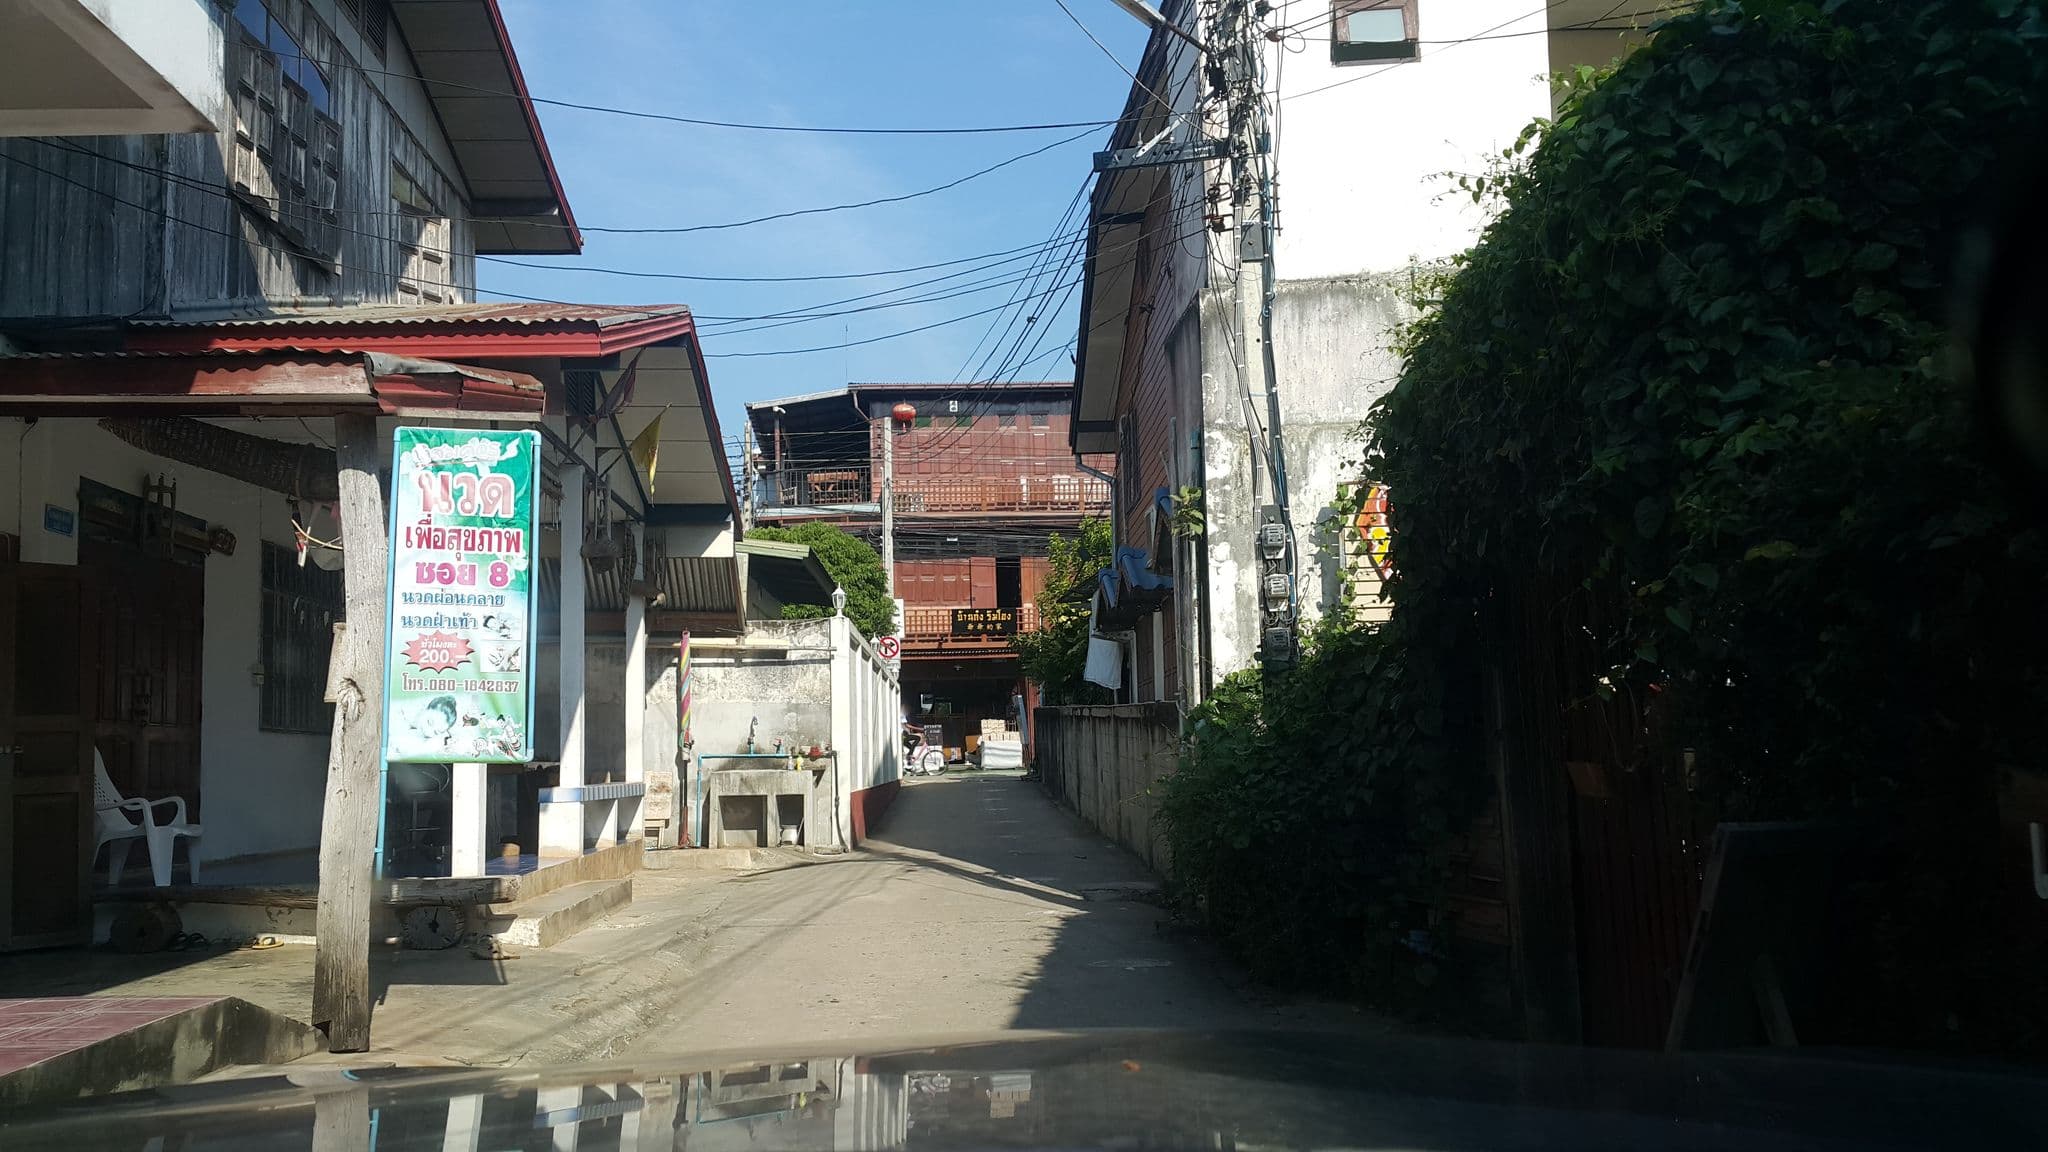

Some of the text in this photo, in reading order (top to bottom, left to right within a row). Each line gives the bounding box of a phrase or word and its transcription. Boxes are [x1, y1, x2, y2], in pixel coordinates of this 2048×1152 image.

[418, 472, 514, 516] นวด
[405, 514, 521, 561] เพื่อสุขภาพ
[415, 561, 509, 587] ซอย 8
[402, 588, 505, 607] นวดผ่อนคลาย
[400, 611, 478, 629] นวดฝ่าเท้า
